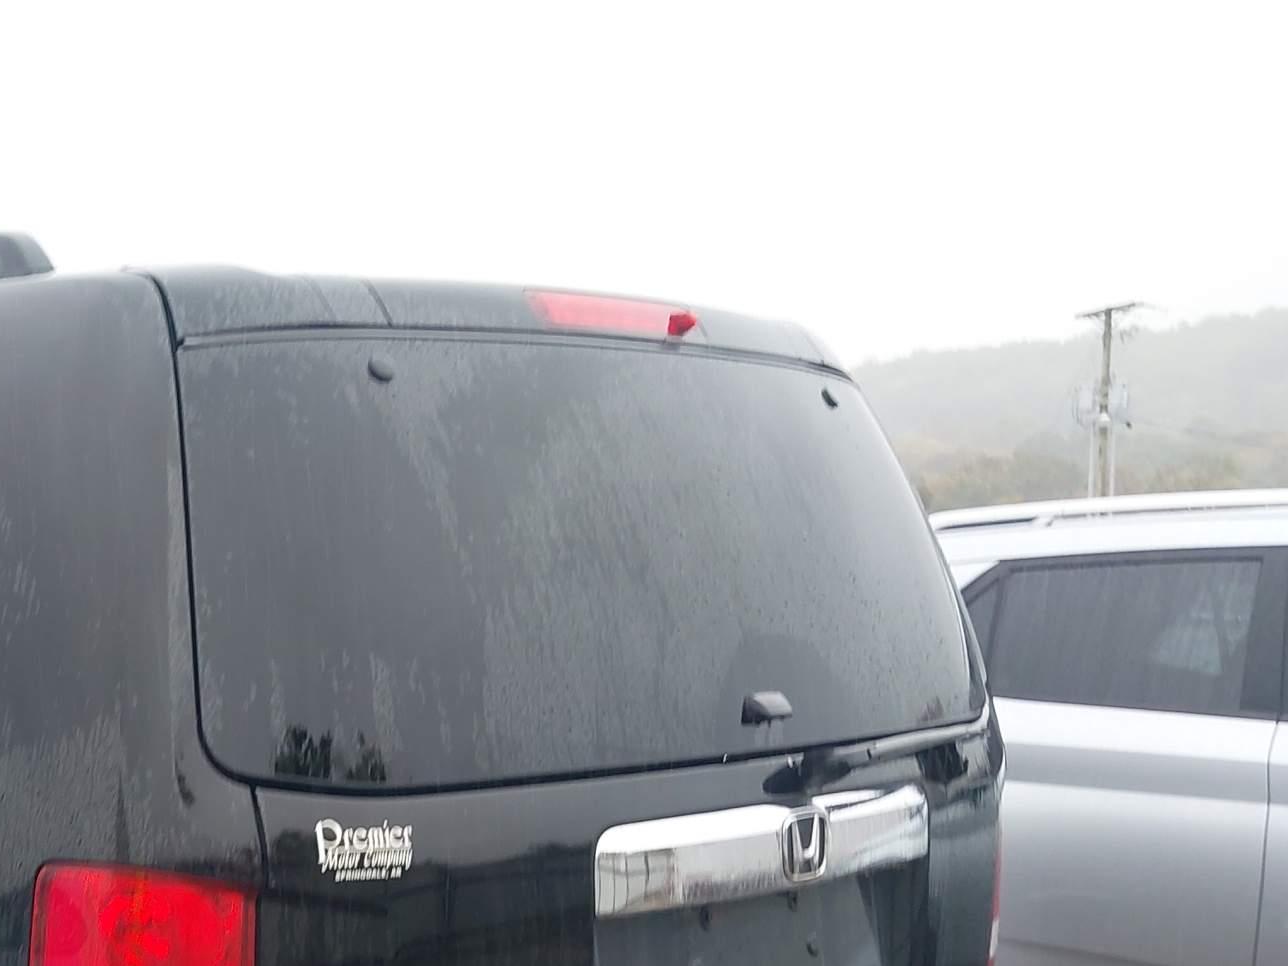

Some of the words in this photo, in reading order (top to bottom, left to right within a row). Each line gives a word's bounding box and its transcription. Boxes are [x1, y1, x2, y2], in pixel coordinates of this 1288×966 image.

[315, 818, 412, 864] Premier
[321, 848, 361, 874] Motor
[364, 848, 413, 871] Company
